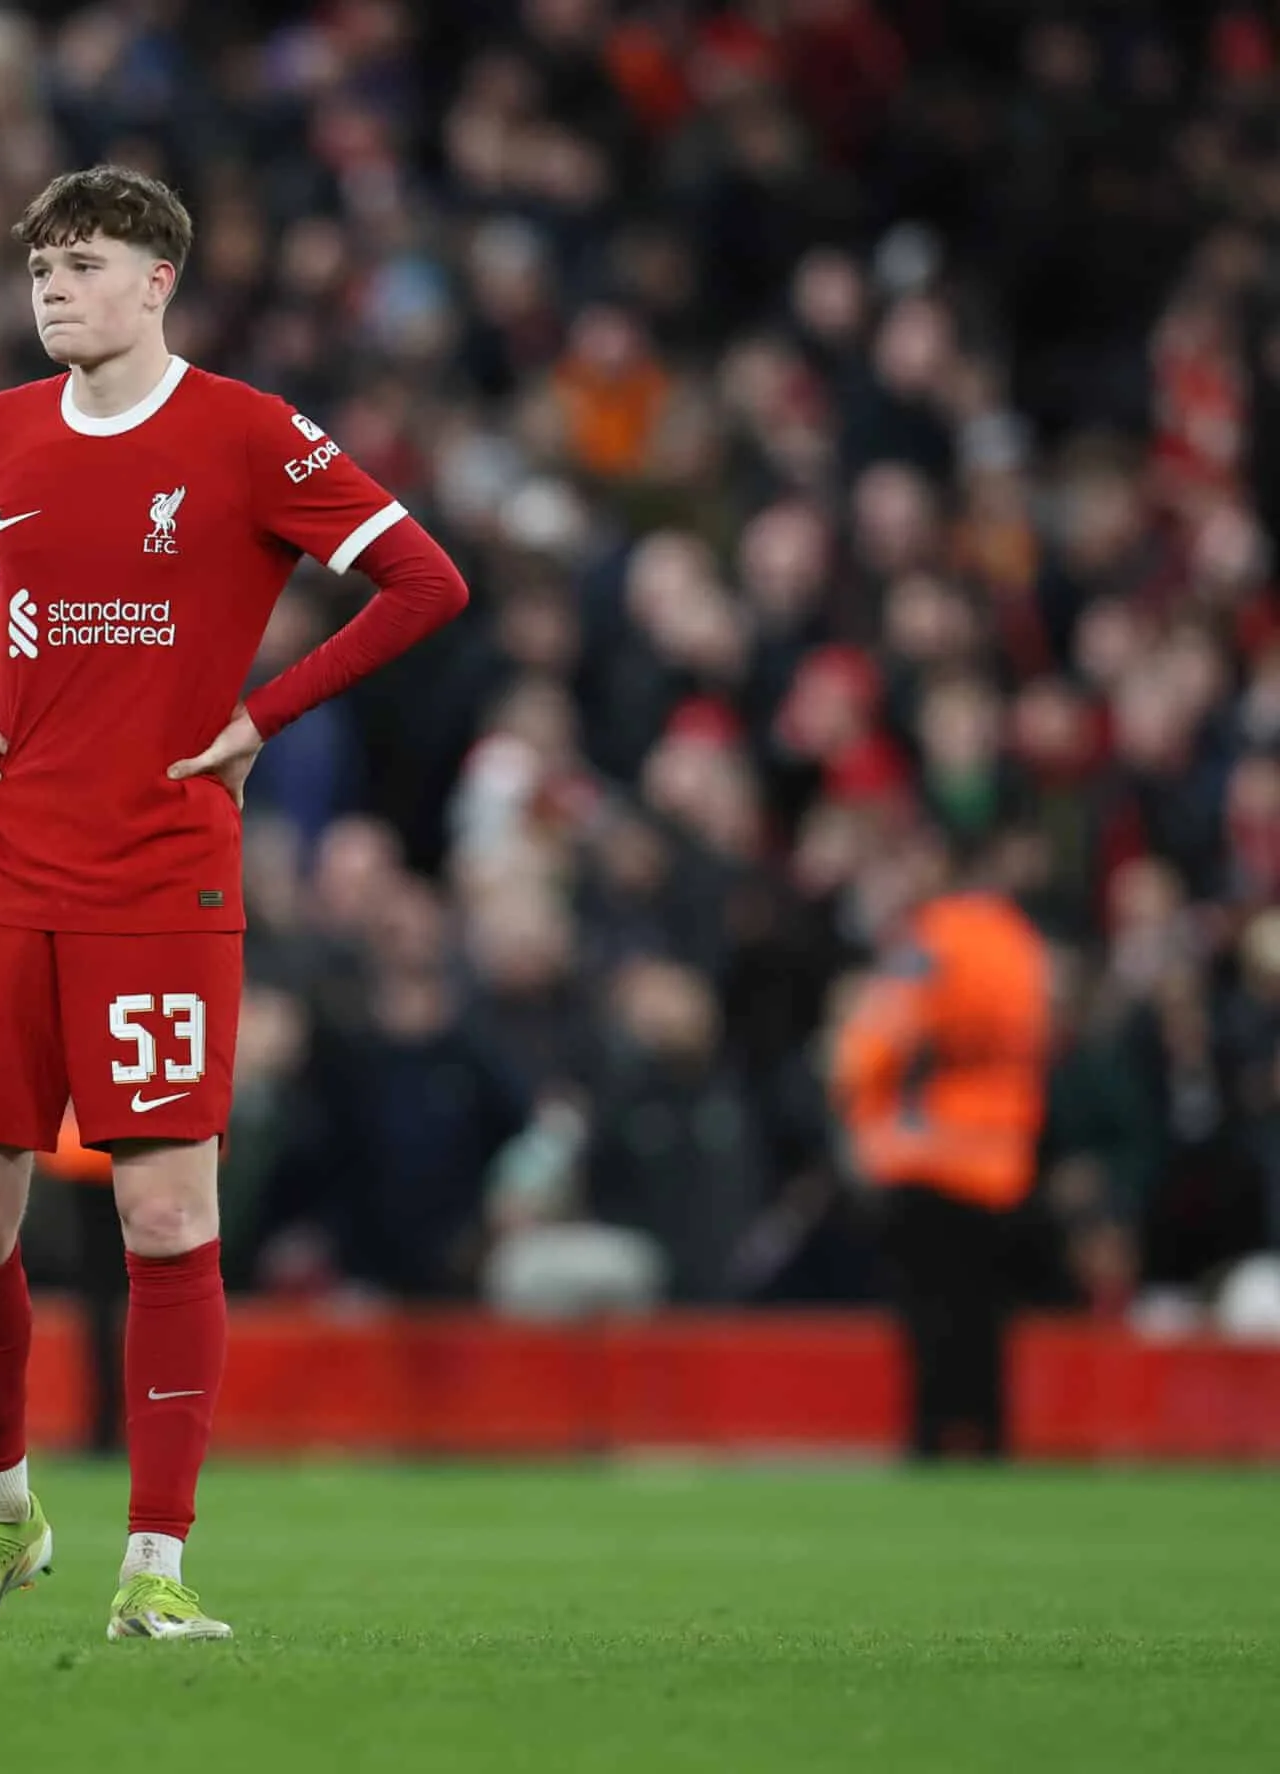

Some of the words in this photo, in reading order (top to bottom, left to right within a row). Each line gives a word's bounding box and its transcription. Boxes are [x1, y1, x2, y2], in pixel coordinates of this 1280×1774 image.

[47, 598, 170, 622] standard
[47, 621, 175, 646] chartered
[109, 993, 206, 1083] 53
